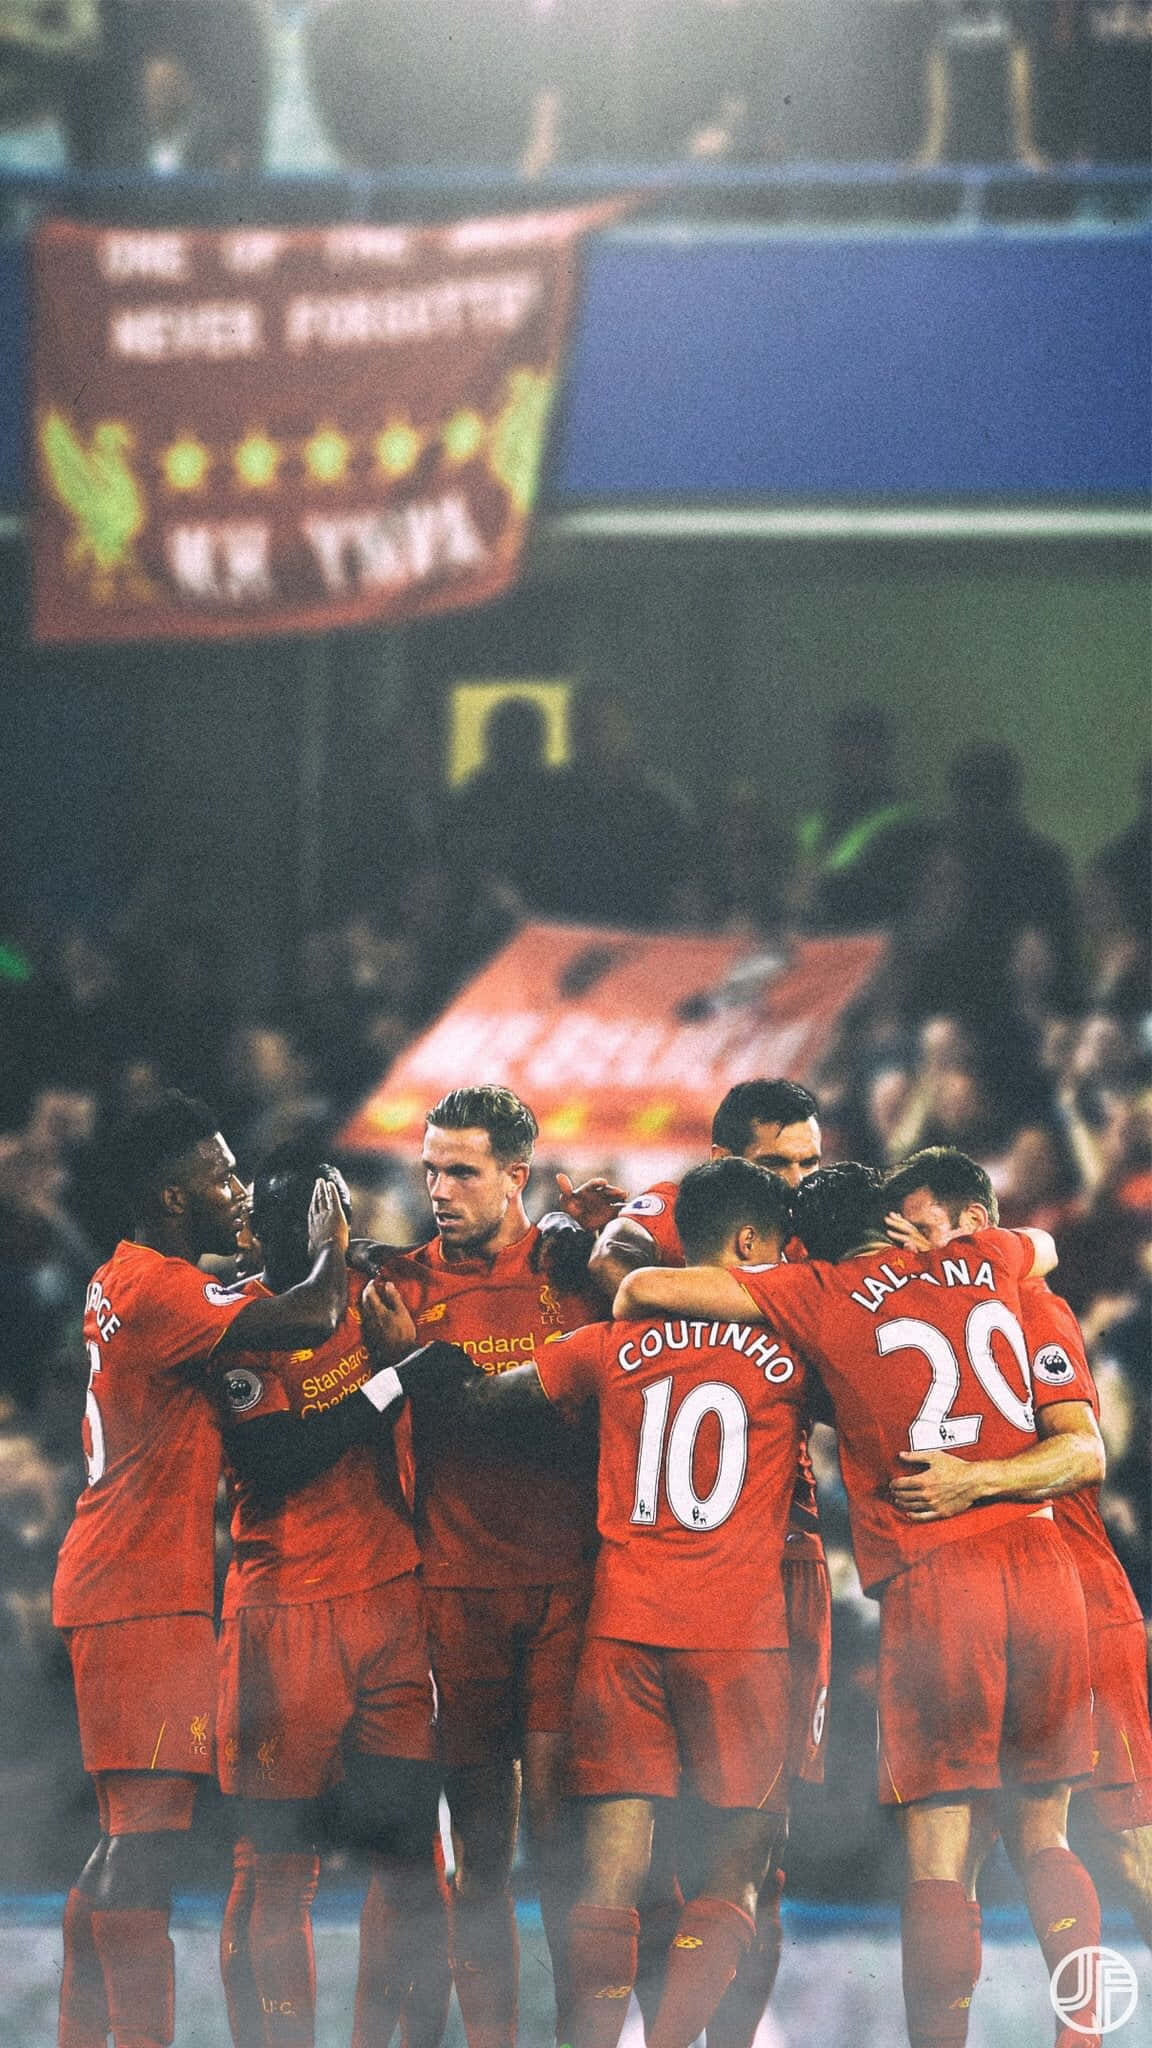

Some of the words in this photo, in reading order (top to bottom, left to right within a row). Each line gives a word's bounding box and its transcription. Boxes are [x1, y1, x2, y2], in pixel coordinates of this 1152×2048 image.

[850, 1258, 996, 1313] LALNA
[450, 1332, 535, 1355] ndard
[617, 1319, 795, 1384] COUTINHO
[875, 1299, 1037, 1452] 20
[630, 1375, 749, 1532] 10
